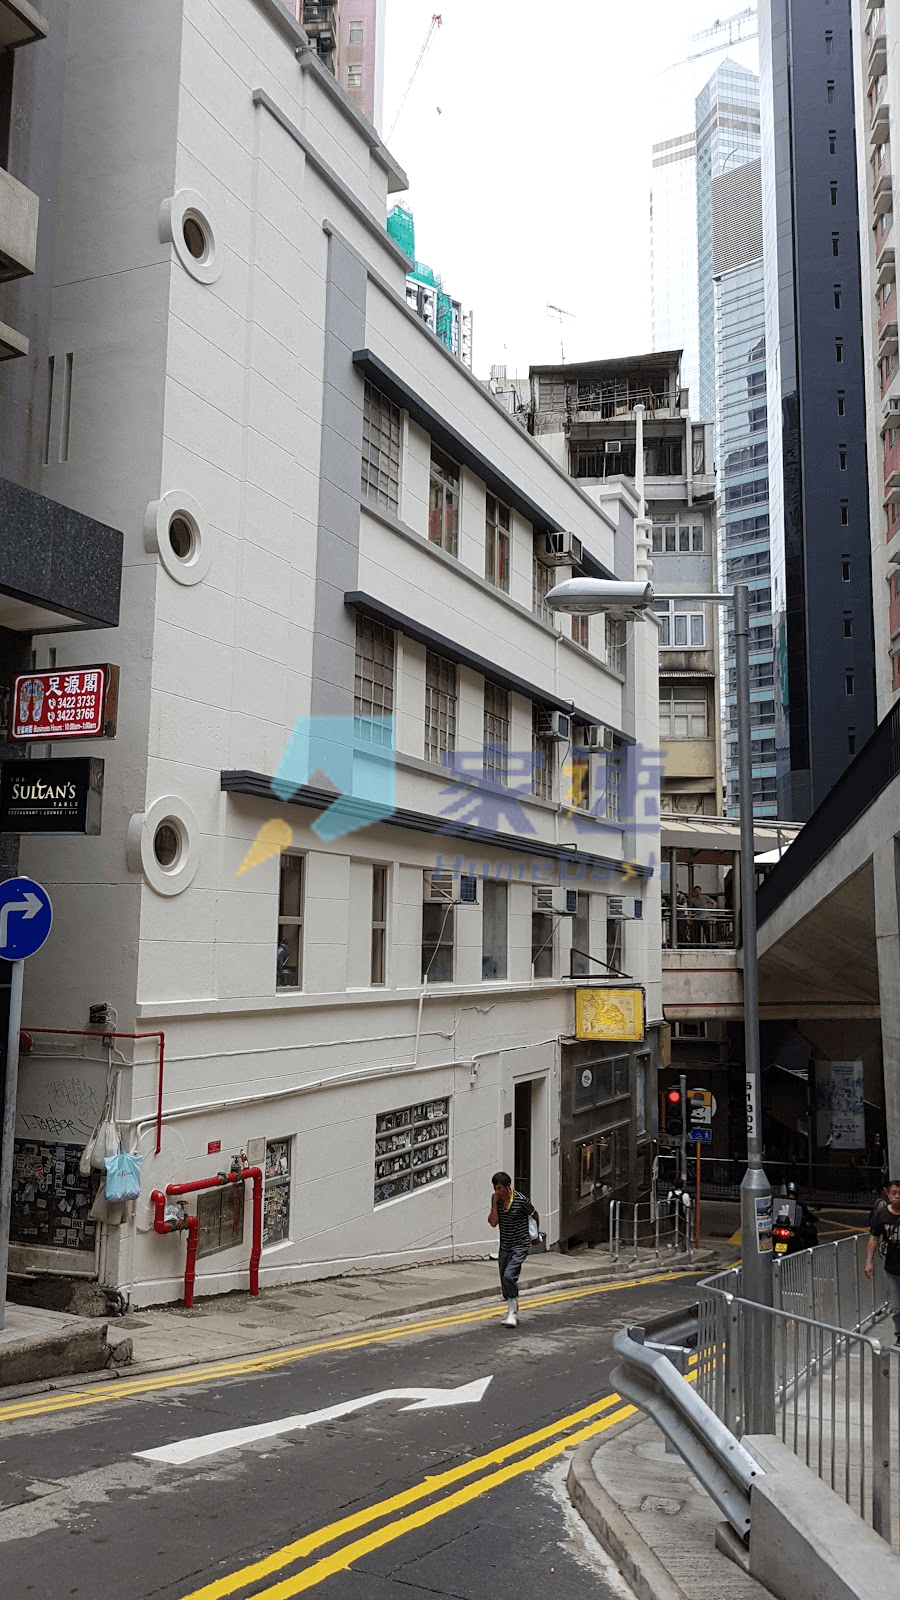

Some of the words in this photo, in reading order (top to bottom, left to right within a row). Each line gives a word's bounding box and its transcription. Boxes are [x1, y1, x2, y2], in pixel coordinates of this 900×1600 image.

[45, 673, 98, 696] 足源閣
[57, 696, 76, 709] 3422
[77, 695, 95, 707] 3733
[56, 709, 75, 722] 3422
[76, 708, 94, 720] 3766
[33, 724, 51, 733] Business
[12, 778, 76, 800] SULTAN'S
[746, 1081, 754, 1134] 51302
